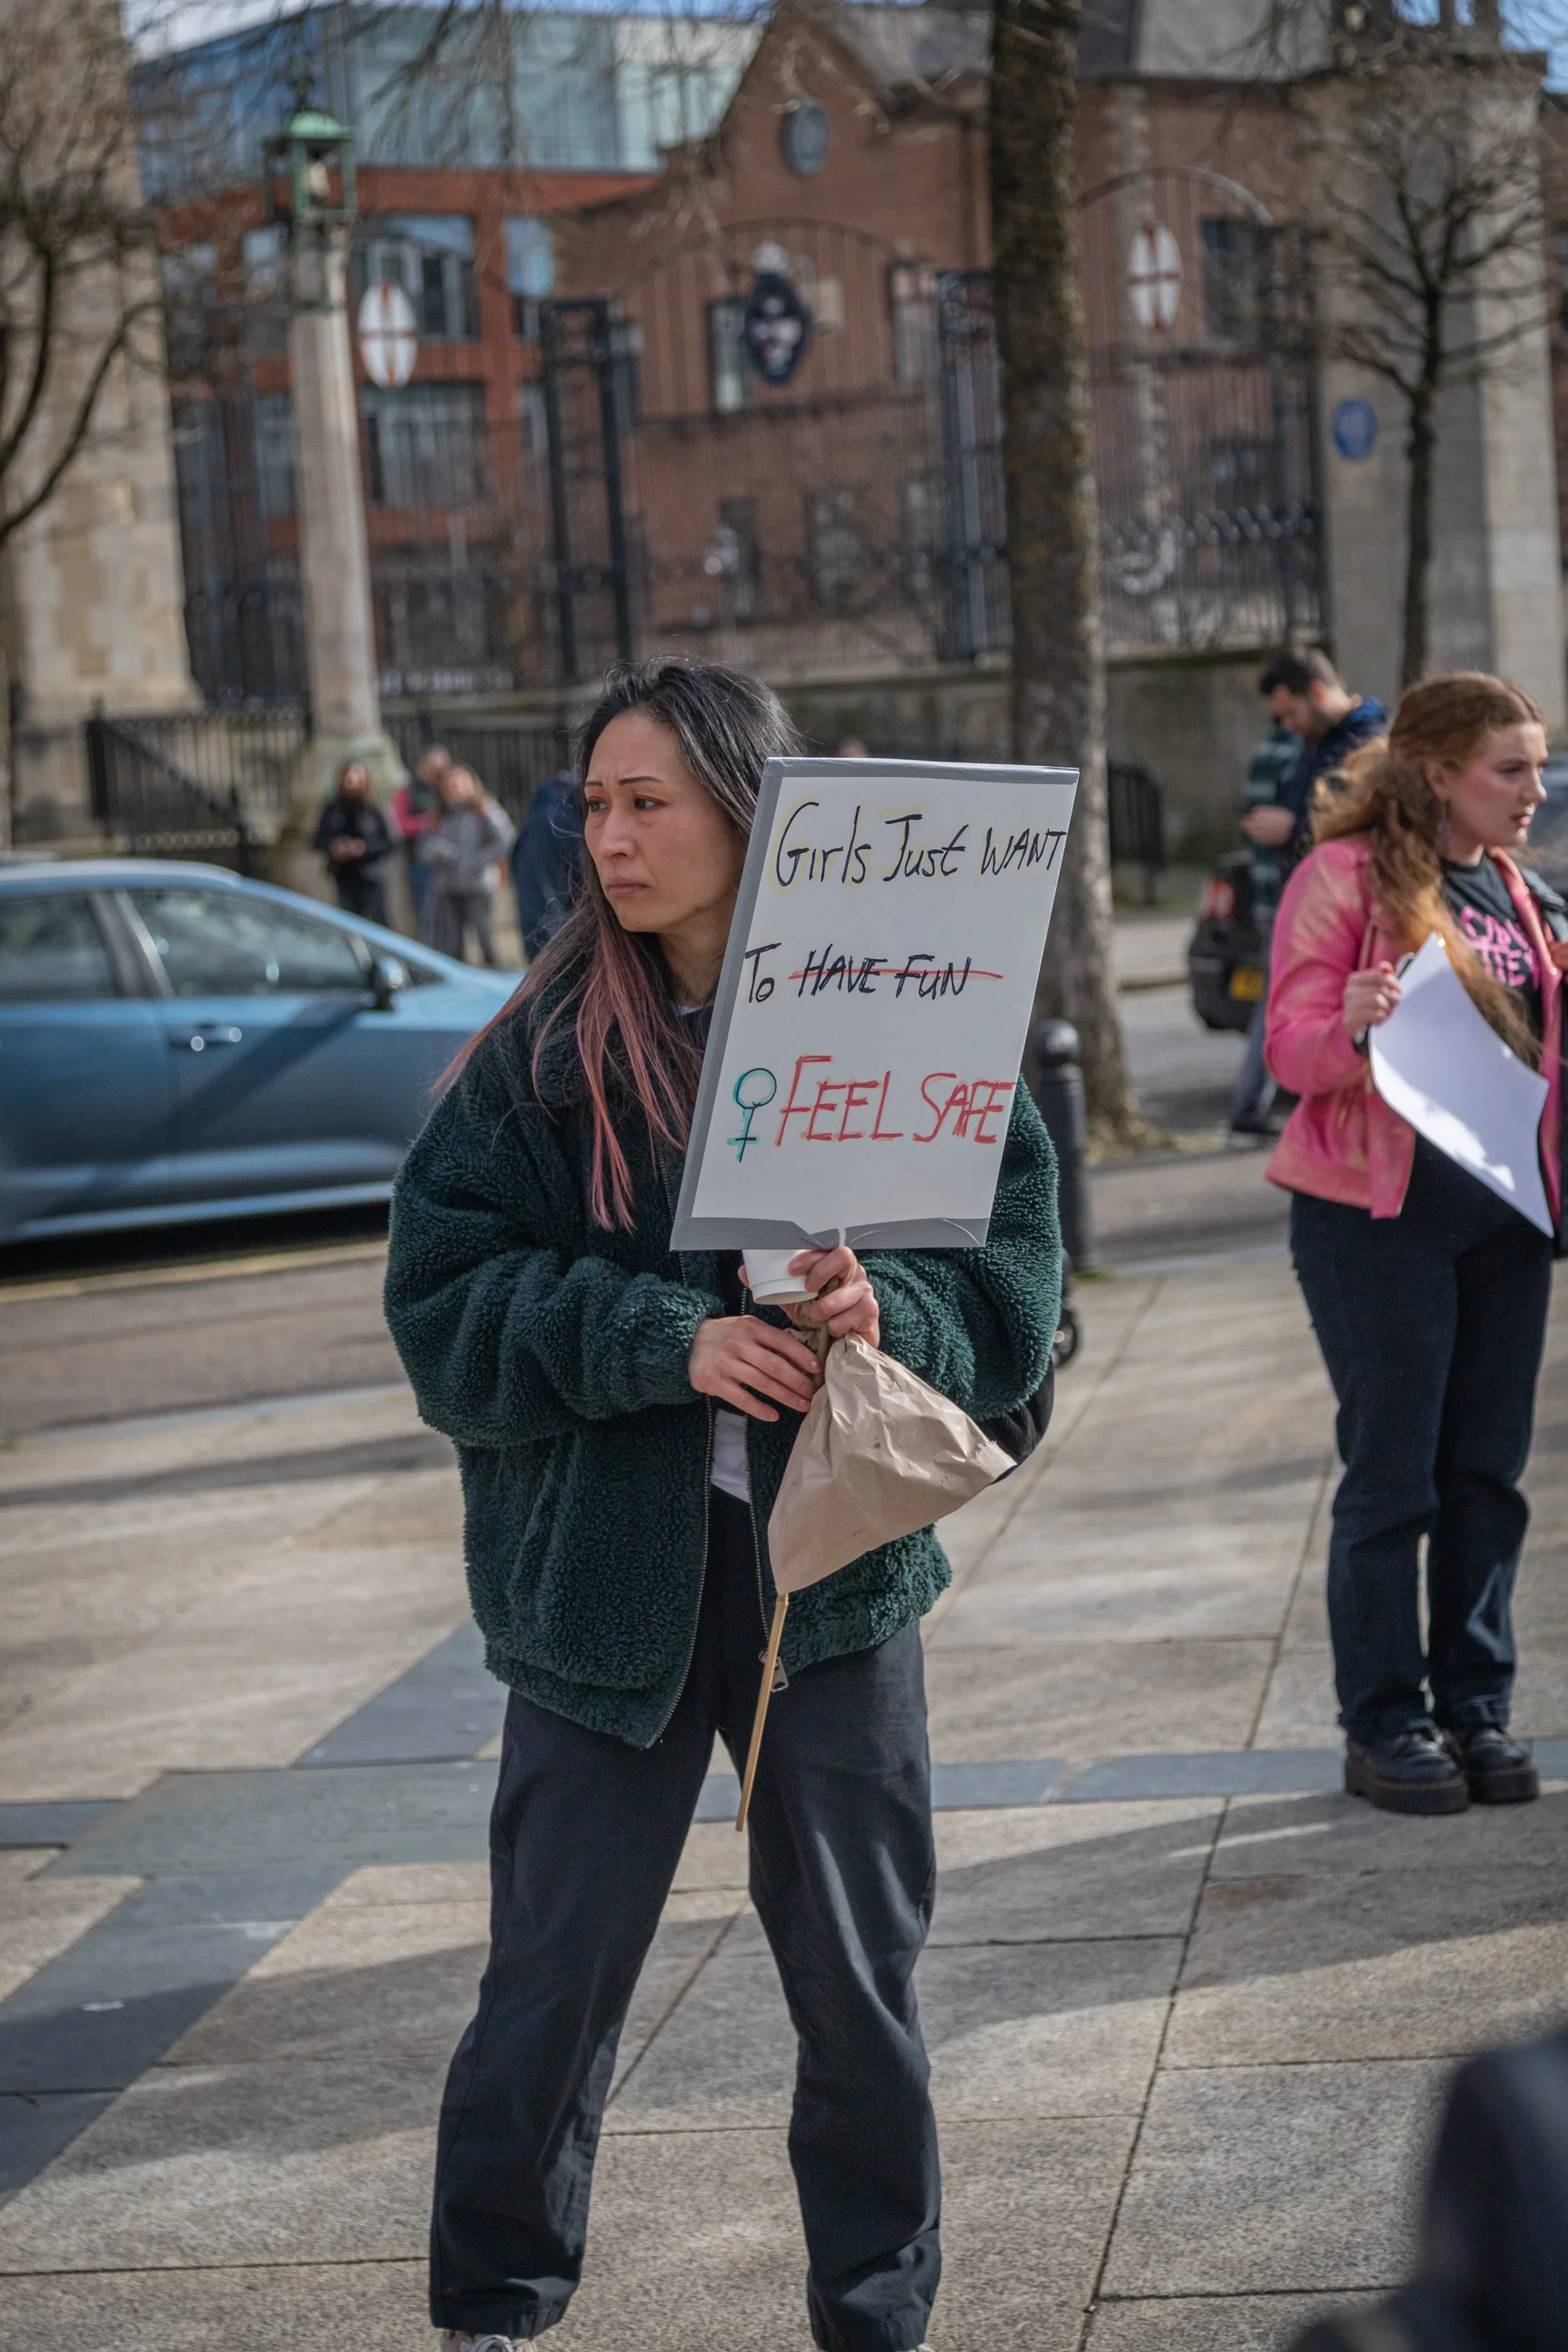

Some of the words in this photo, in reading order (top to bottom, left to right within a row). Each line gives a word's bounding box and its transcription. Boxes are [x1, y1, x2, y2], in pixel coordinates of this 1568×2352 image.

[775, 801, 871, 887] Girls
[884, 813, 969, 883] Just
[982, 826, 1067, 876] WANT
[797, 944, 888, 998] HAVE
[775, 1055, 904, 1146] FEEL
[913, 1072, 1017, 1144] SAFE
